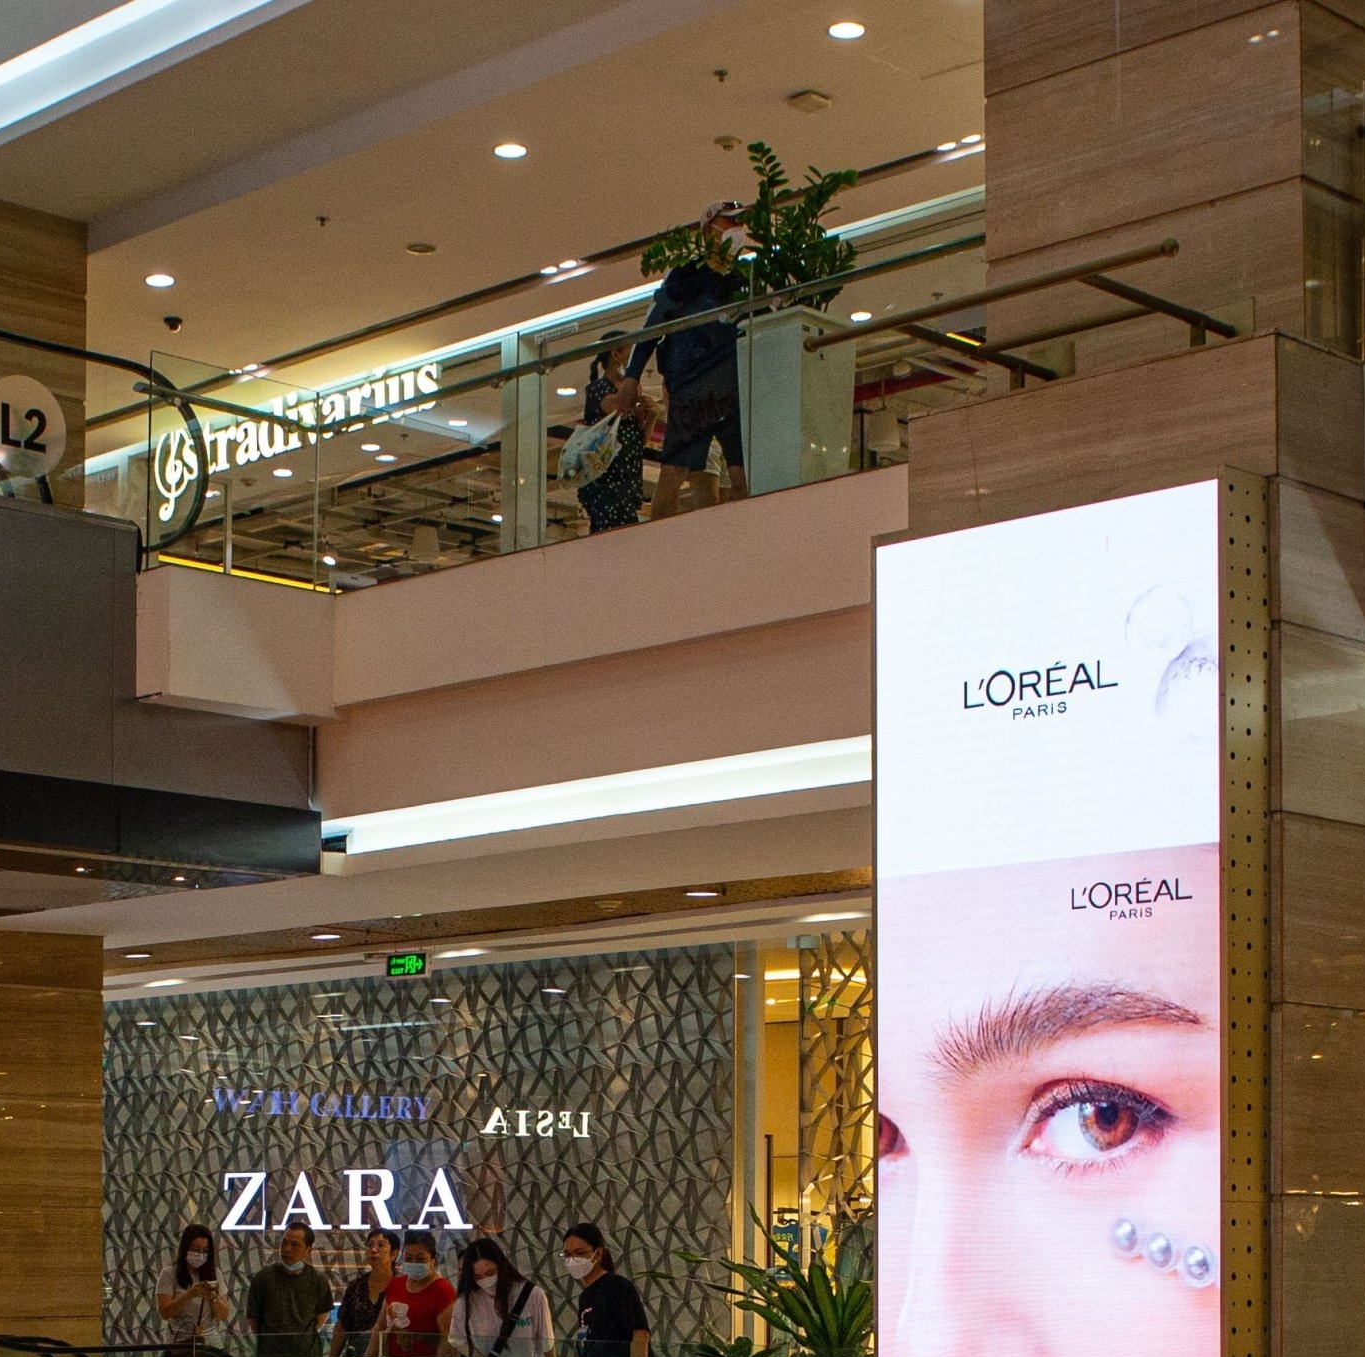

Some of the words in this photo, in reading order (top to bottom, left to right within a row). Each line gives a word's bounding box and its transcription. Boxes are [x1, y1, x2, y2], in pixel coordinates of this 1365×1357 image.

[0, 402, 47, 454] L2
[962, 660, 1119, 710] L'ORÉAL
[1012, 701, 1068, 721] PARIS
[1071, 877, 1193, 911] L'ORÉAL
[1109, 906, 1154, 921] PARIS
[220, 1167, 474, 1232] ZARA
